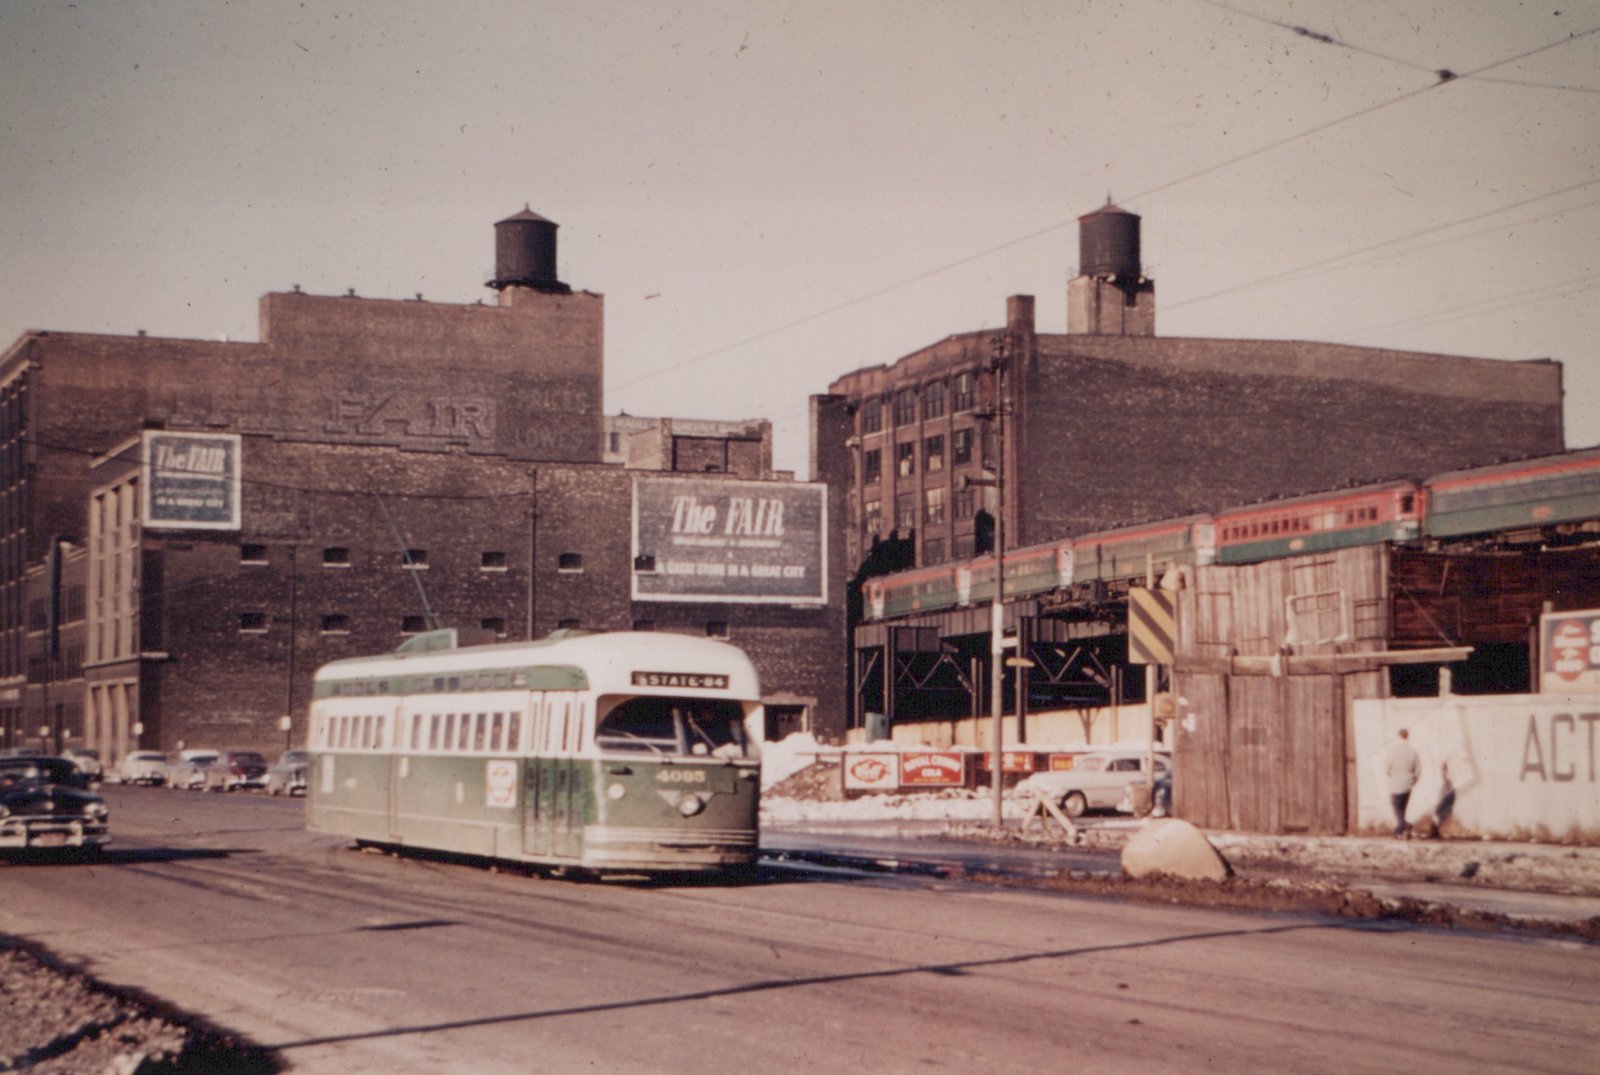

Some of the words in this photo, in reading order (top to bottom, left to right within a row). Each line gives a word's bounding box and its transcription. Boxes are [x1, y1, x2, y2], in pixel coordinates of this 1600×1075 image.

[156, 445, 186, 471] The
[186, 445, 226, 473] FAIR
[670, 495, 717, 534] The
[724, 496, 786, 537] FAIR
[655, 769, 707, 783] 4095
